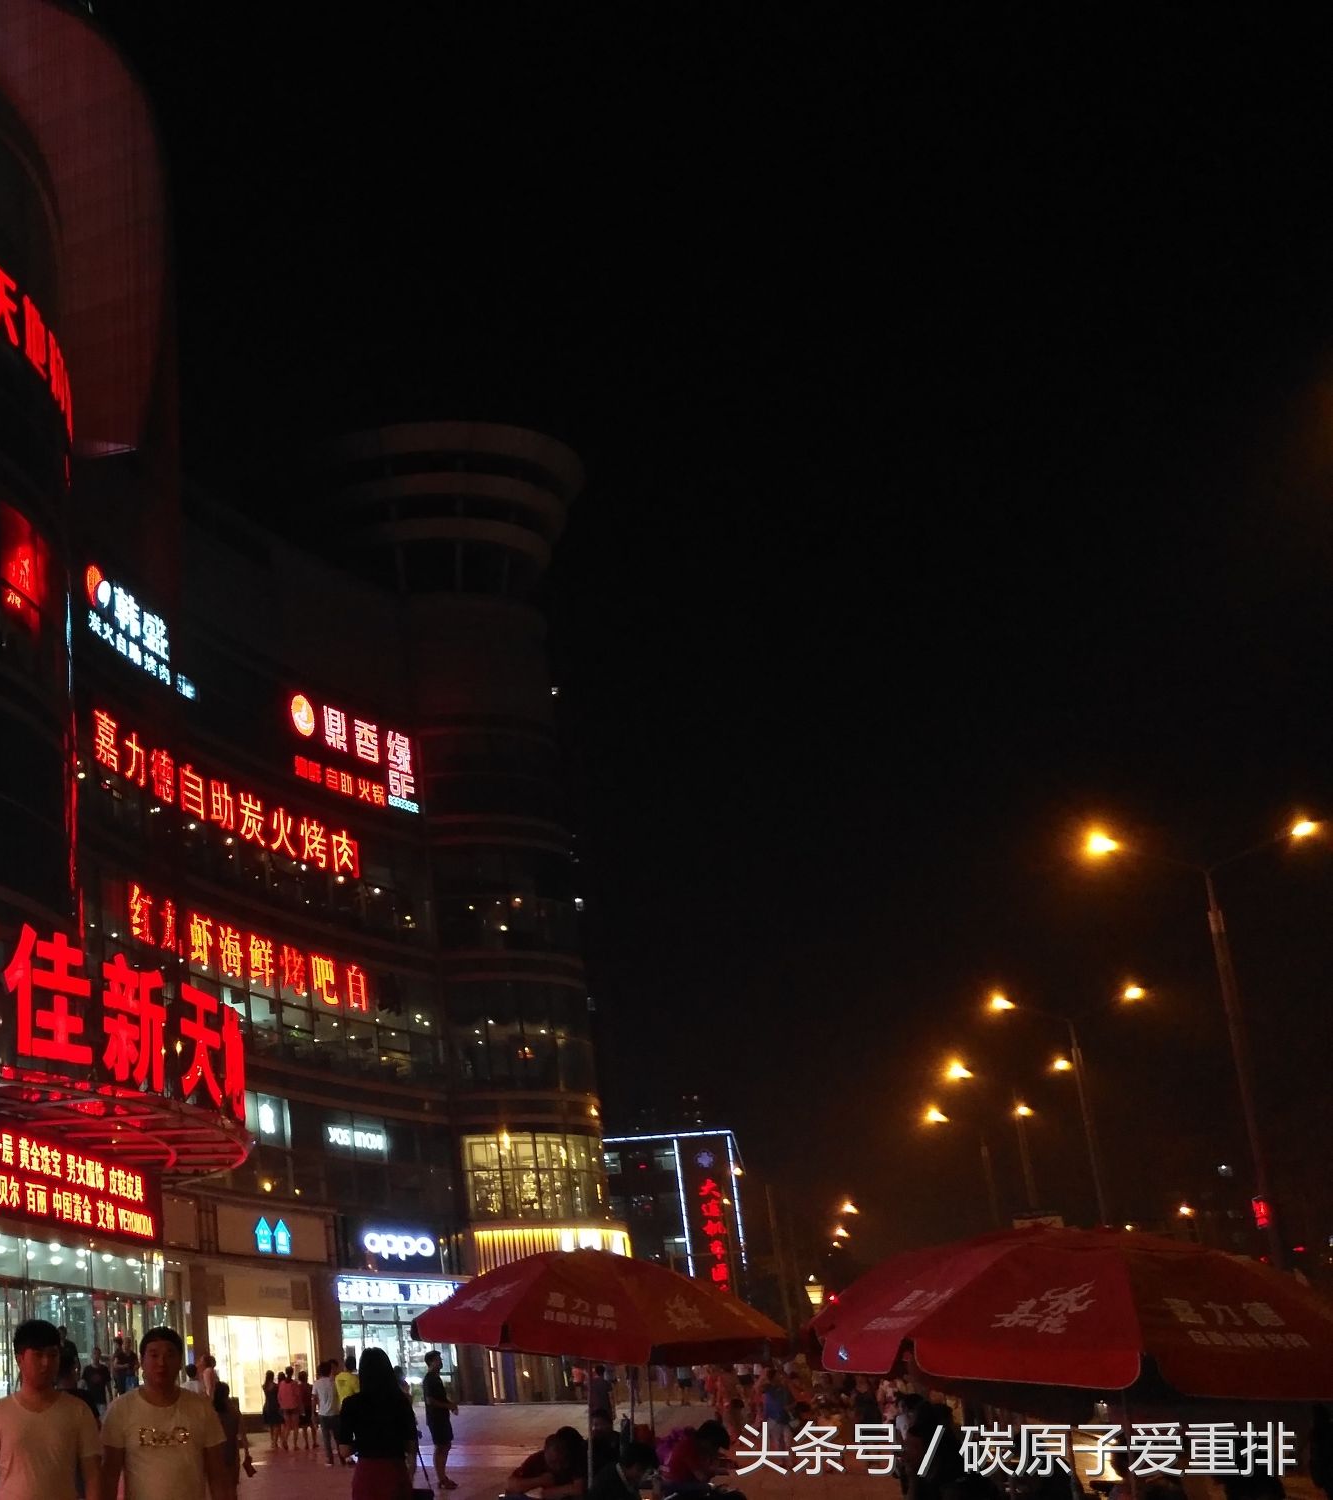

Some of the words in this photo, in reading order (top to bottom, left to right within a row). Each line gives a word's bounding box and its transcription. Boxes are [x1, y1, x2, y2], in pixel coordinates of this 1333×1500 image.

[388, 770, 415, 799] 5F
[19, 1137, 62, 1178] 黄金珠宝
[67, 1154, 105, 1191] 男女服饰
[109, 1167, 144, 1202] 皮鞋皮具
[25, 1182, 48, 1214] 百丽
[52, 1187, 92, 1225] 中国黄金
[96, 1200, 115, 1230] 艾格
[363, 1232, 436, 1261] oppo
